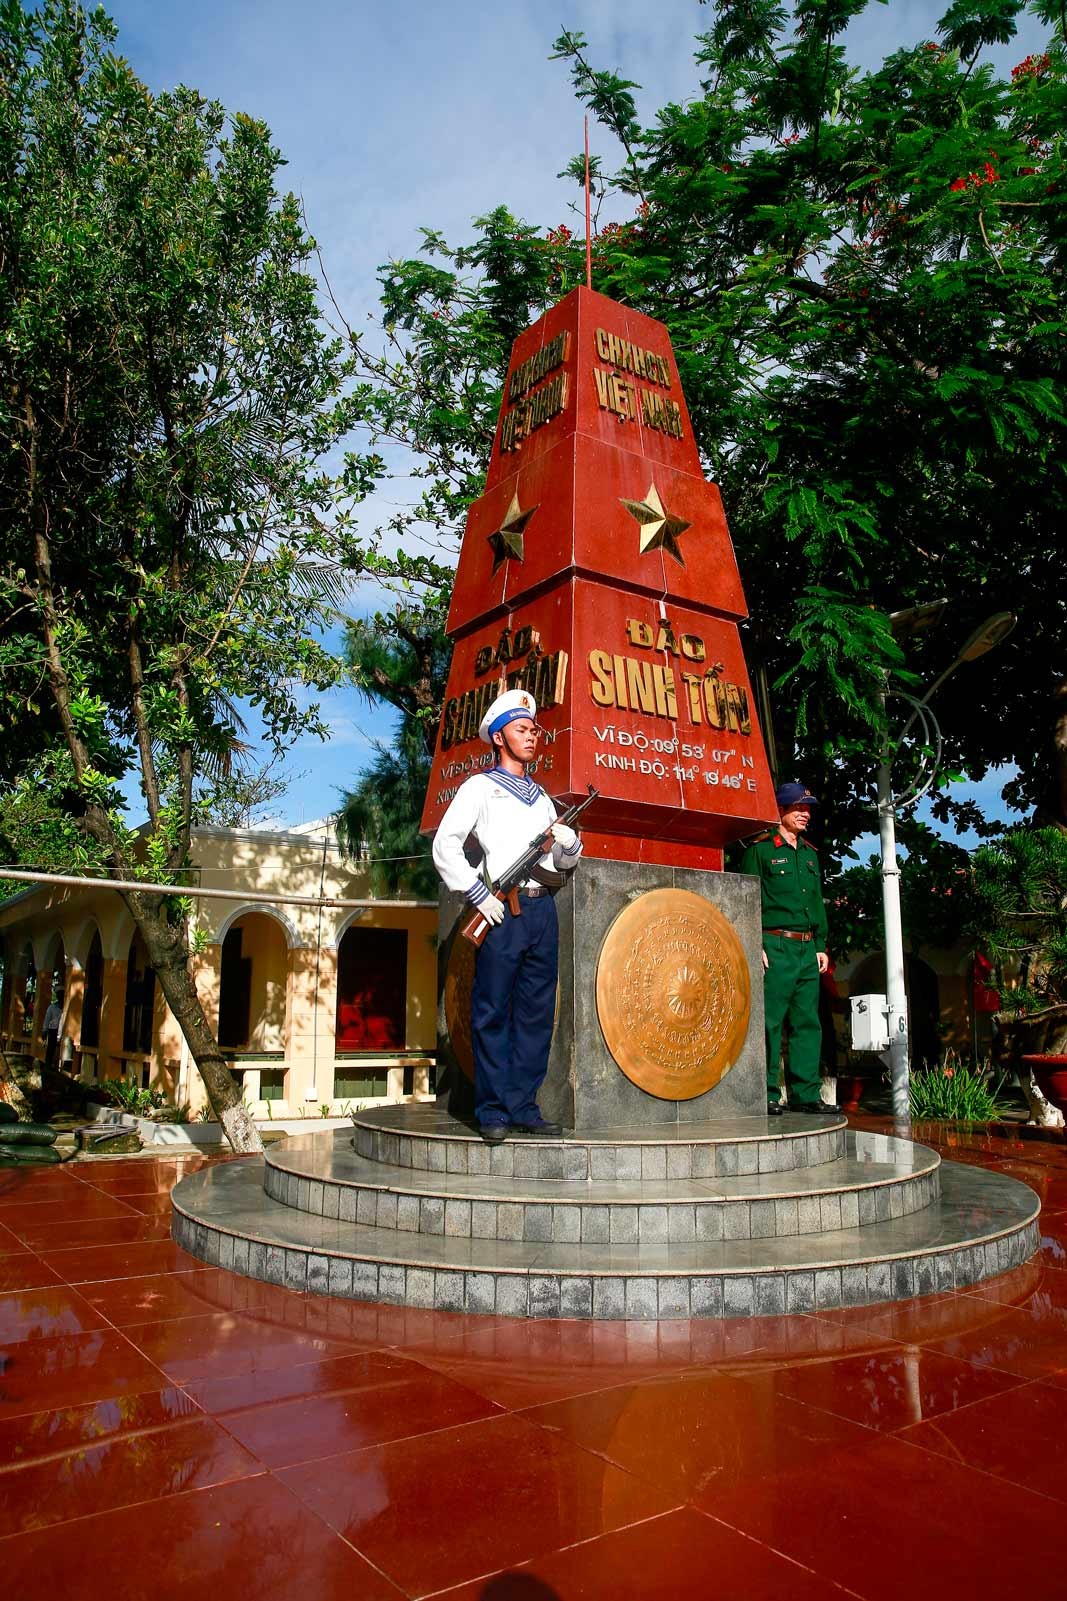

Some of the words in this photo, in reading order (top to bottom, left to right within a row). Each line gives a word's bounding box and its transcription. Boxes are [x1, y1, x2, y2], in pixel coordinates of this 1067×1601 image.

[594, 367, 635, 423] VIỆT
[626, 617, 707, 663] ĐẢO
[588, 649, 679, 721] SINH
[593, 725, 615, 743] VĨ
[741, 754, 755, 768] N
[594, 752, 636, 772] KINH
[747, 778, 757, 792] E
